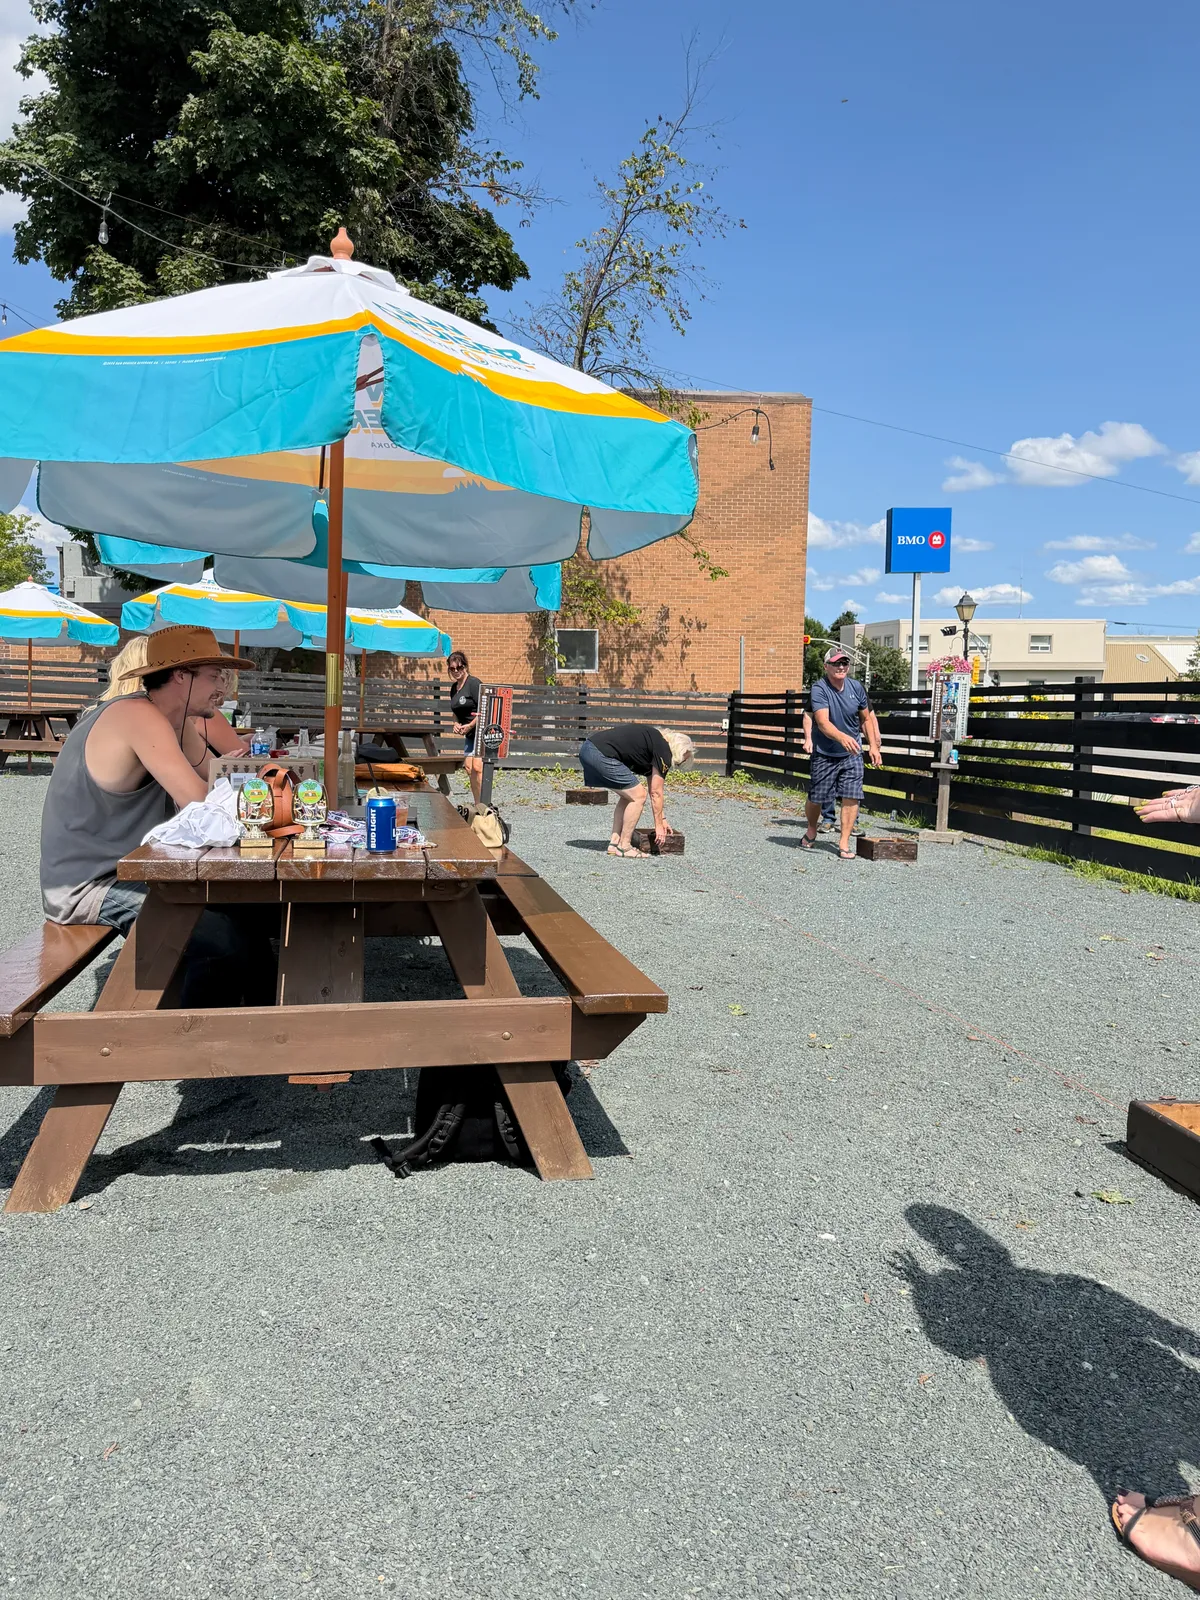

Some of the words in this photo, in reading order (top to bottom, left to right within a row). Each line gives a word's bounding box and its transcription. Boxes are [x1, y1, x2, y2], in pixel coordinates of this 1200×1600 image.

[371, 301, 536, 369] CRUISER
[386, 303, 472, 341] SUN
[897, 535, 926, 545] BMO
